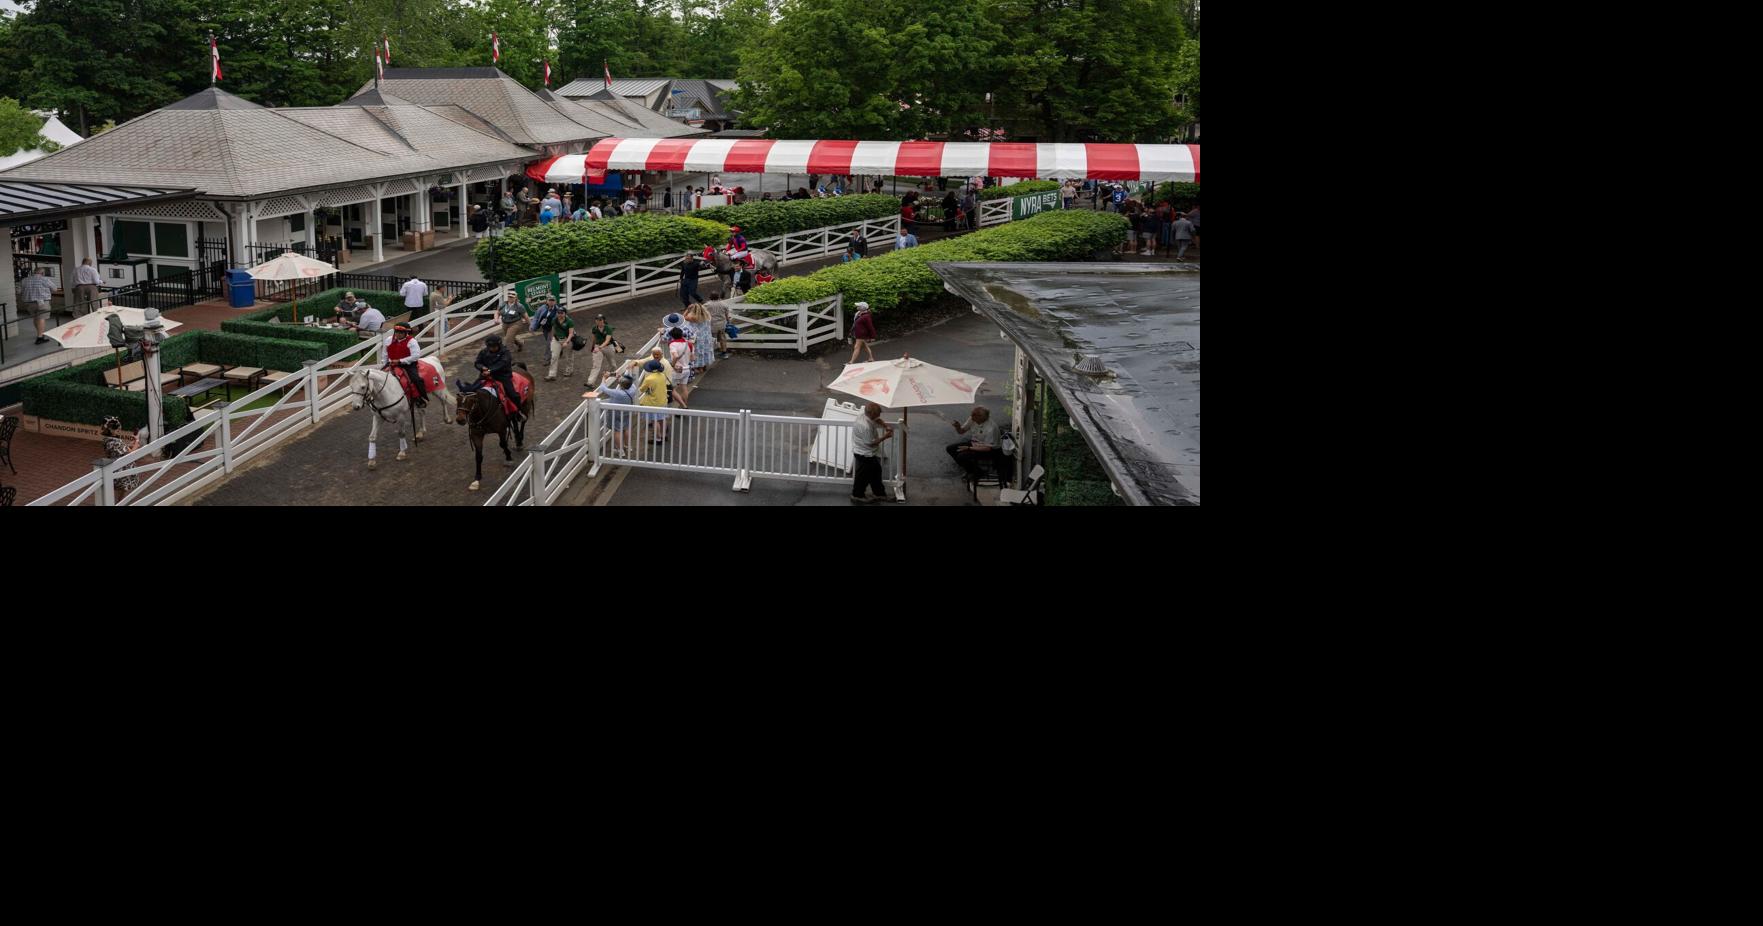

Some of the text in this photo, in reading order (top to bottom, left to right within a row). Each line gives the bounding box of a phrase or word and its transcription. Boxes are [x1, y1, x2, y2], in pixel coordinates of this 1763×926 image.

[1020, 192, 1057, 216] NYRA BETS
[1115, 194, 1122, 202] 3
[44, 423, 76, 433] CHANDON
[77, 427, 99, 436] SPRITZ
